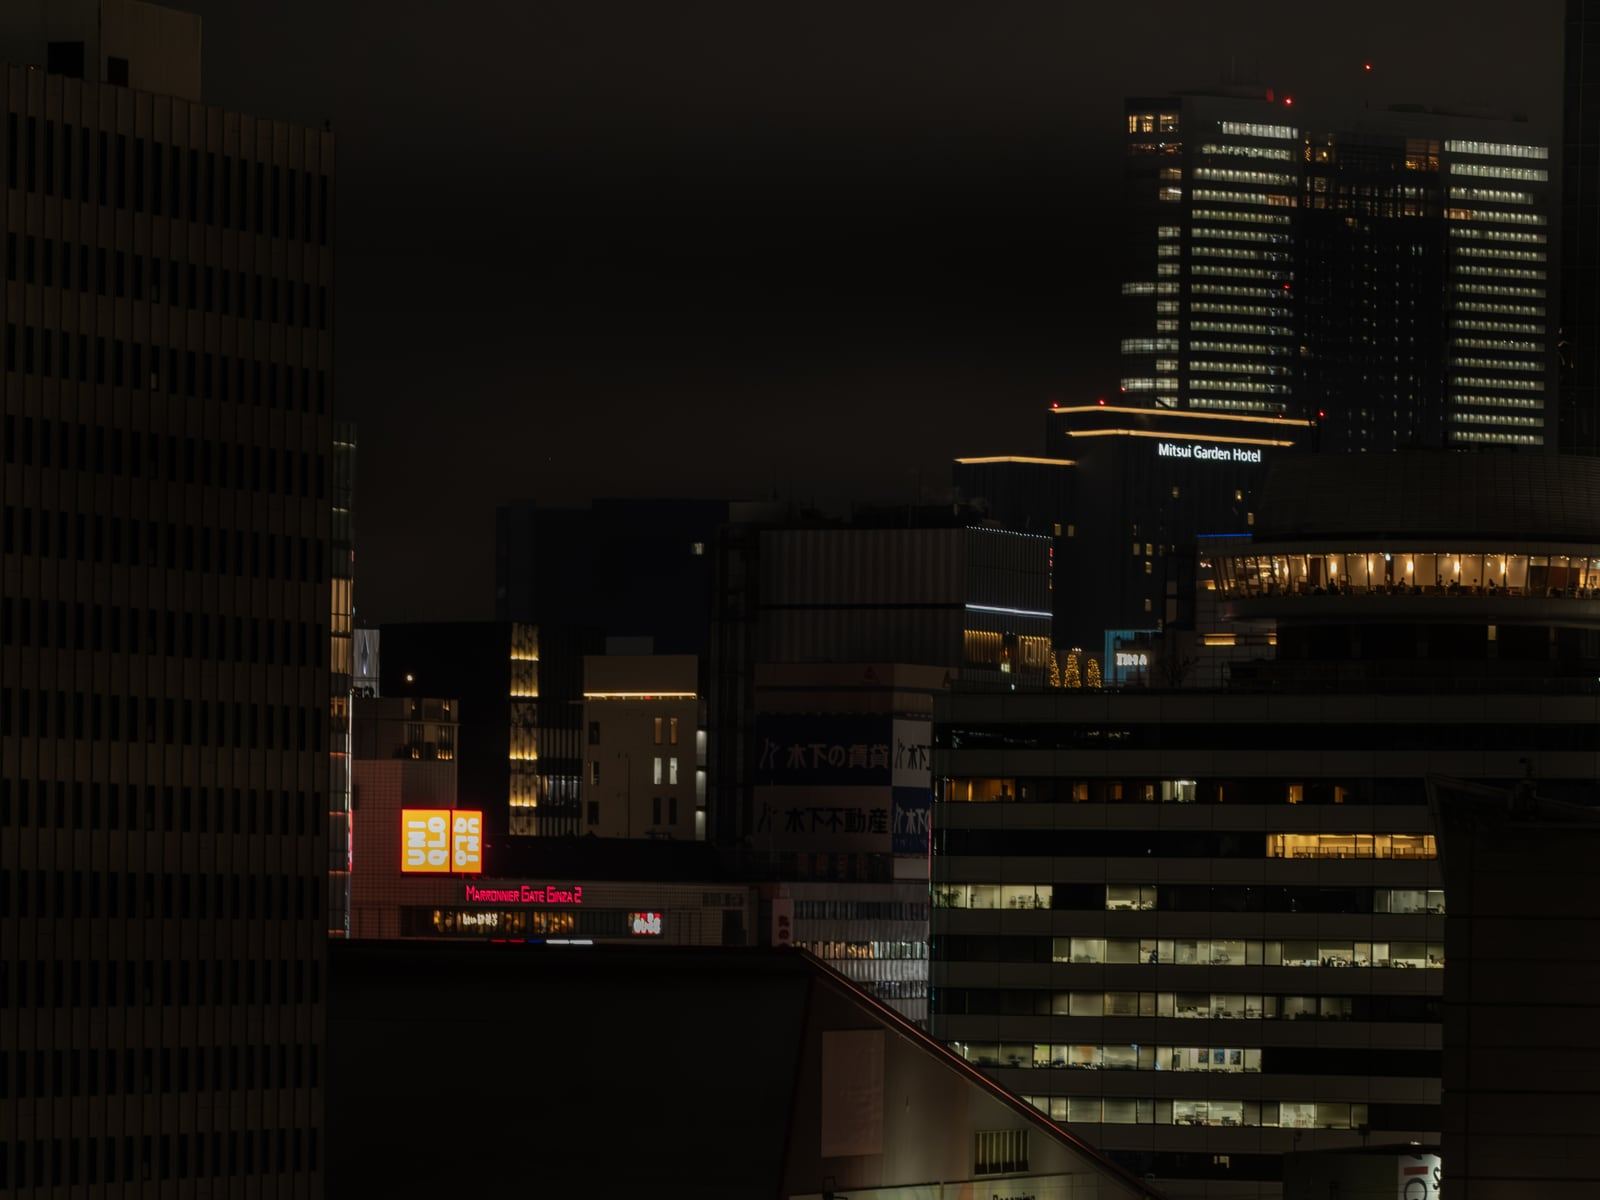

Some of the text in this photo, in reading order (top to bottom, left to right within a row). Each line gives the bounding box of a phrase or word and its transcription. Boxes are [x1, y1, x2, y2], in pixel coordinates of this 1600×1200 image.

[1158, 443, 1261, 462] Mitsui Garden Hotel
[787, 743, 890, 769] 木下の賃貸
[785, 807, 889, 834] 木下不動産
[407, 821, 426, 866] UNI
[427, 816, 448, 866] QLO
[574, 886, 582, 904] 2
